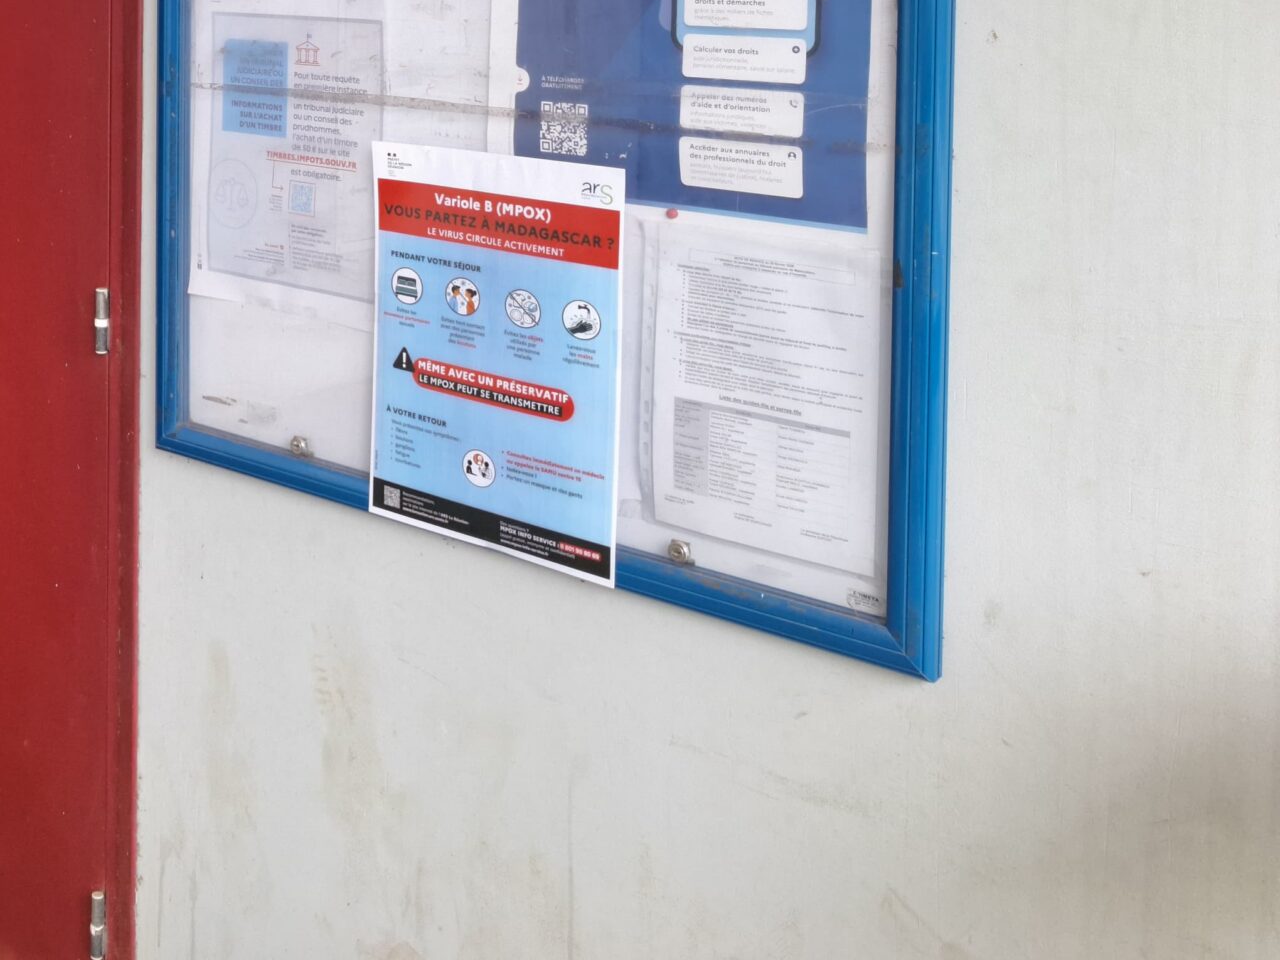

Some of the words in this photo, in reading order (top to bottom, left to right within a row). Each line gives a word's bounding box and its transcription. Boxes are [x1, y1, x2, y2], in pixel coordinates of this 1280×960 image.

[693, 45, 722, 53] Calculer
[737, 47, 759, 55] droits
[332, 76, 361, 85] requête
[231, 100, 283, 111] INFORMATIONS
[304, 104, 331, 113] tribunal
[332, 106, 365, 117] judiciaire
[691, 101, 713, 109] d'aide
[723, 103, 771, 113] d'orientation
[313, 116, 338, 124] conseil
[339, 117, 352, 125] des
[334, 138, 359, 148] timbre
[690, 143, 718, 152] Accéder
[735, 149, 770, 157] annuaires
[703, 154, 755, 165] professionnels
[756, 158, 766, 166] du
[768, 160, 787, 168] droit
[434, 193, 481, 211] Variole
[484, 200, 493, 212] B
[496, 203, 552, 223] (MPOX)
[384, 204, 421, 220] VOUS
[425, 210, 476, 228] PARTEZ
[481, 214, 490, 230] À
[495, 221, 602, 249] MADAGASCAR
[608, 238, 615, 250] ?
[427, 227, 437, 236] LE
[438, 228, 464, 240] VIRUS
[466, 233, 503, 247] CIRCULE
[504, 240, 565, 257] ACTIVEMENT
[391, 250, 426, 263] PENDANT
[427, 255, 452, 268] VOTRE
[453, 259, 481, 273] SÉJOUR
[418, 359, 445, 376] MÊME
[448, 368, 475, 383] AVEC
[478, 375, 493, 387] UN
[496, 377, 569, 404] PRÉSERVATIF
[419, 374, 428, 384] LE
[430, 376, 454, 390] MPOX
[456, 383, 478, 396] PEUT
[480, 389, 491, 399] SE
[493, 392, 560, 416] TRANSMETTRE
[393, 407, 416, 419] VOTRE
[418, 414, 447, 428] RETOUR
[500, 526, 517, 534] MPOX
[518, 530, 531, 539] INFO
[533, 535, 556, 547] SERVICE
